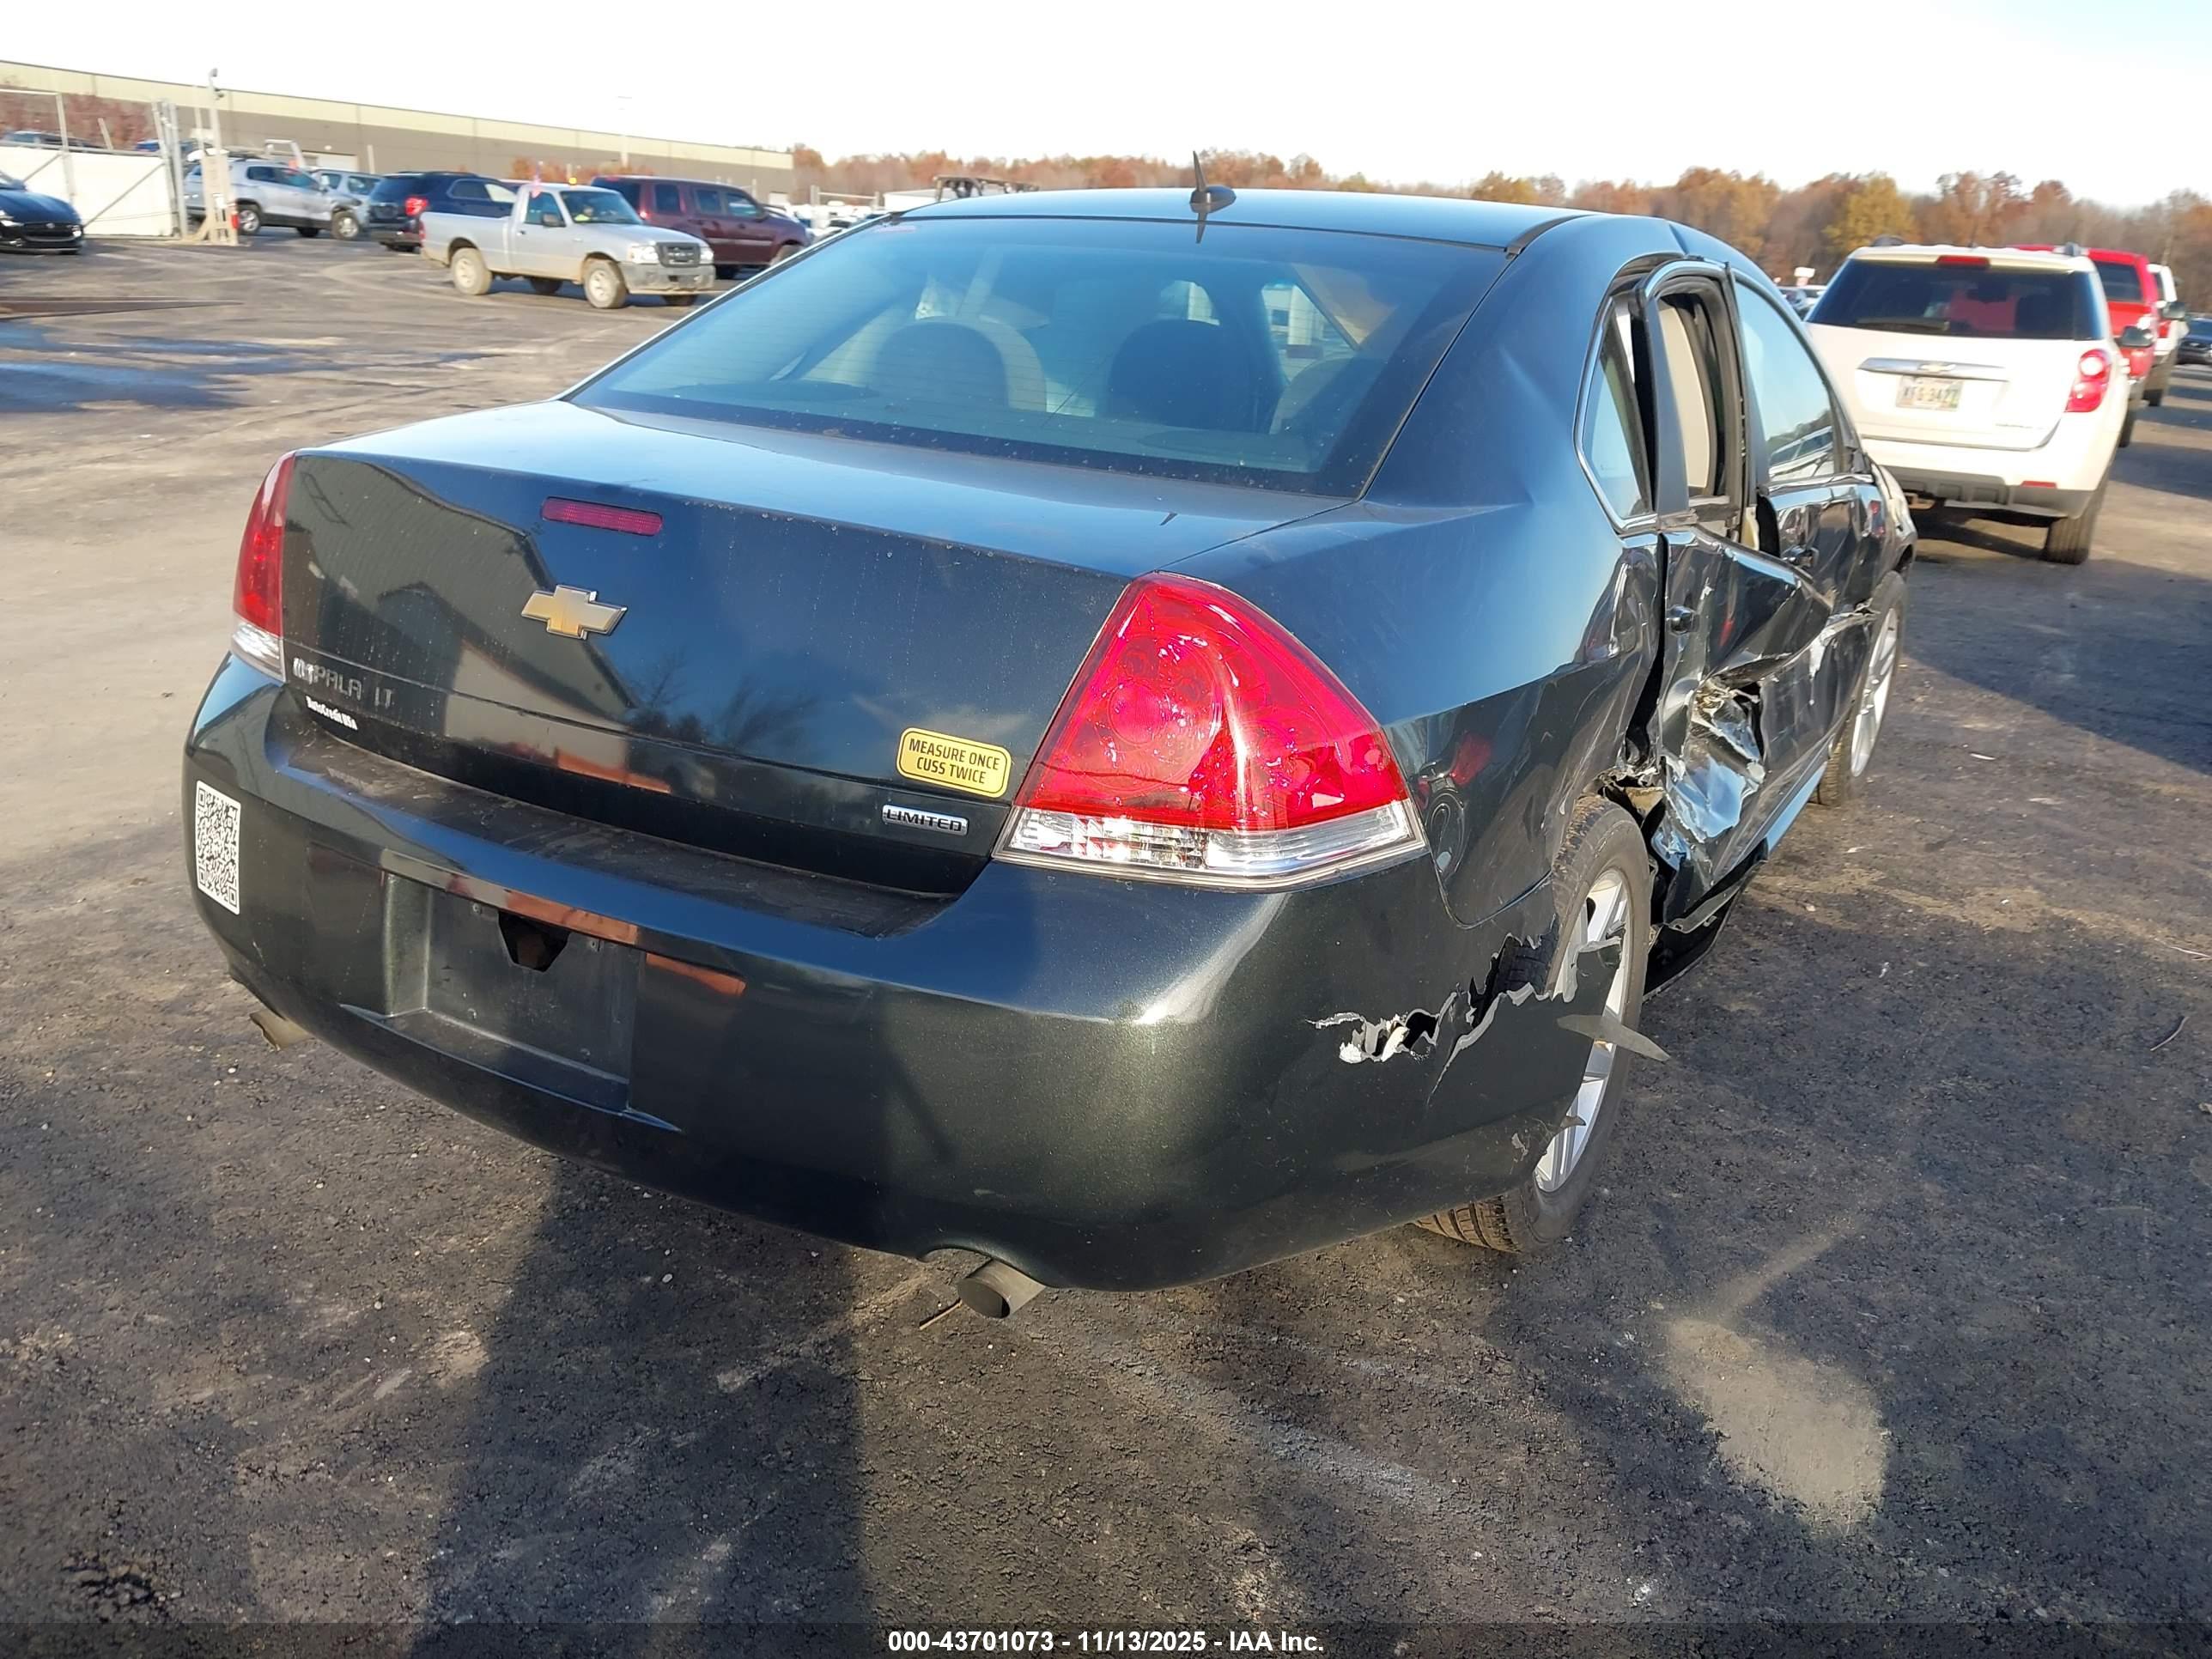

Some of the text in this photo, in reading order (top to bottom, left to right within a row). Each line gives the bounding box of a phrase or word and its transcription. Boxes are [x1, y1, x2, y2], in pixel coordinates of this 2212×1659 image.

[908, 738, 1001, 771] MEASURE ONCE
[916, 757, 987, 785] CUSS TWICE
[885, 808, 963, 833] LIMITED
